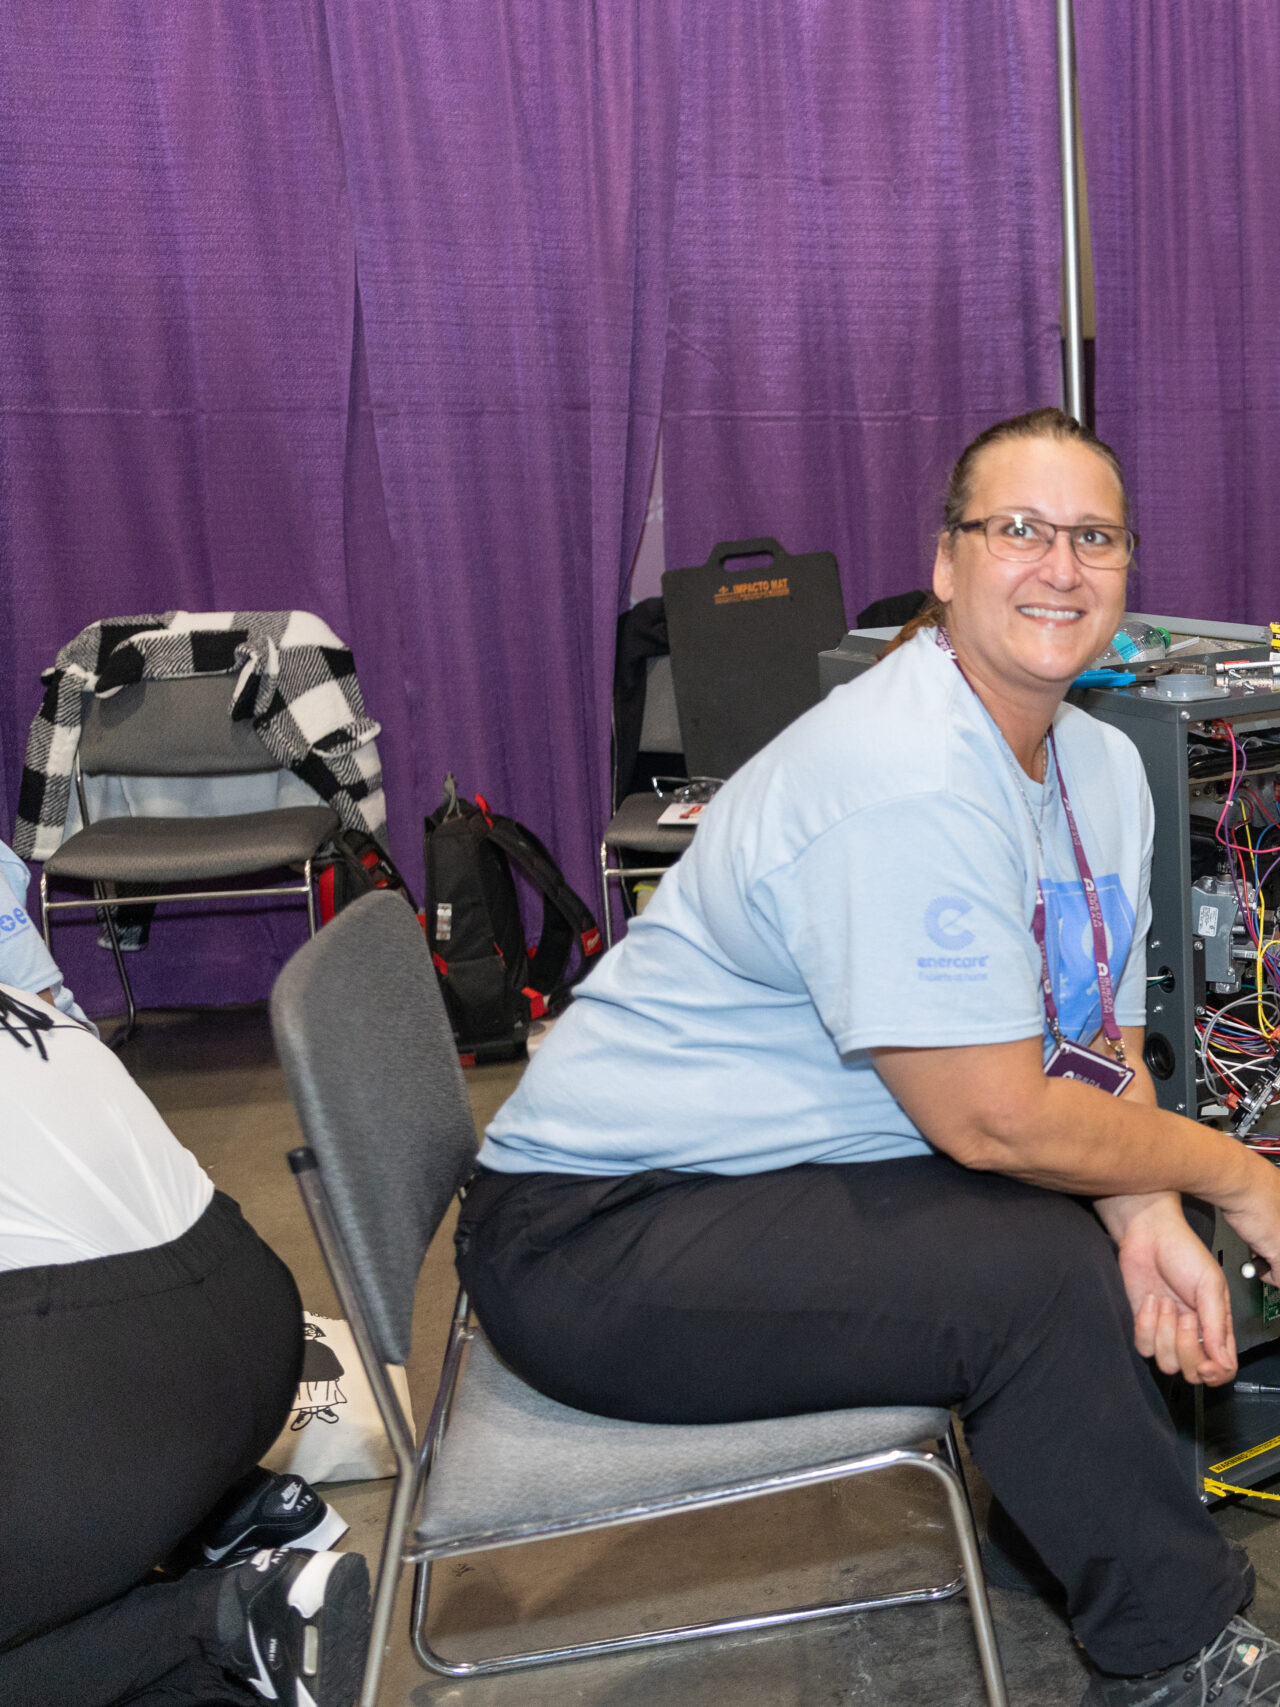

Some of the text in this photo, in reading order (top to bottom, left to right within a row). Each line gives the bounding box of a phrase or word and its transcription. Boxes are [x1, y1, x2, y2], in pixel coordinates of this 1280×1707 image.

[917, 955, 988, 969] enercare
[1215, 1454, 1248, 1471] WARNING
[296, 1494, 312, 1511] AIR
